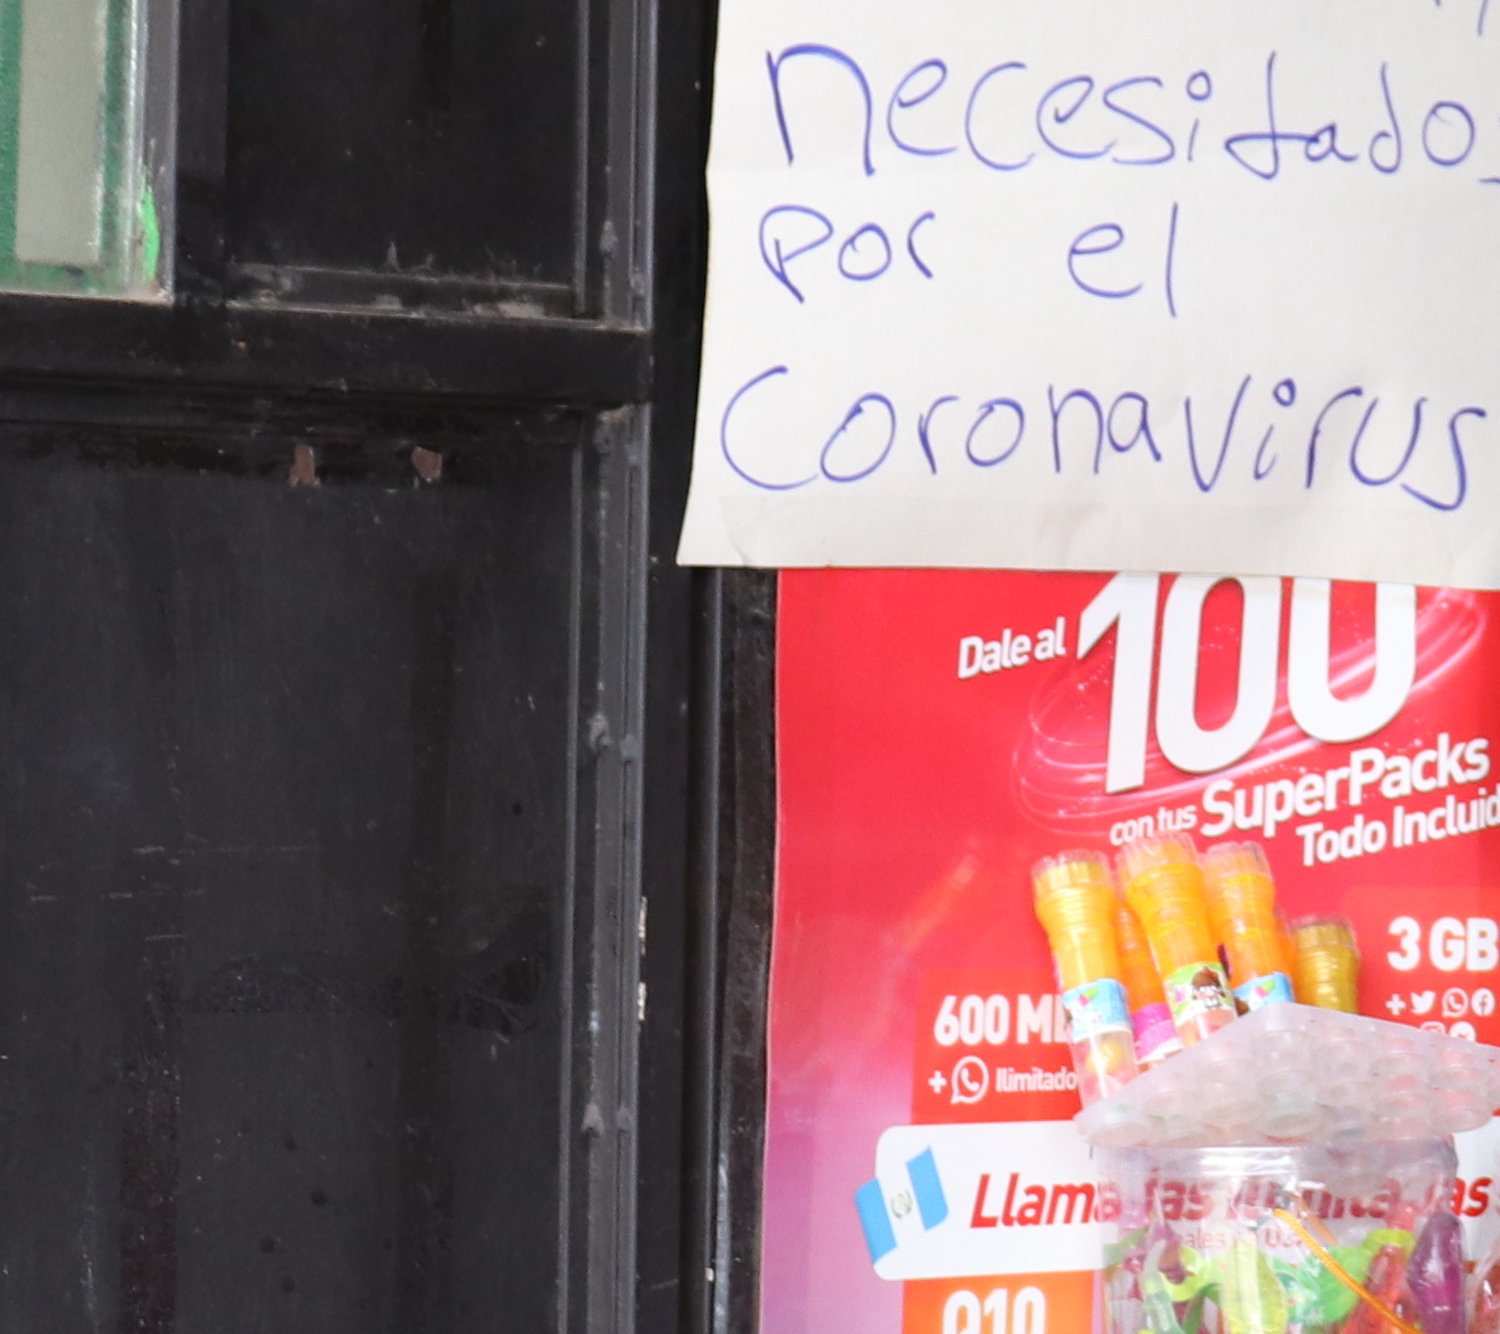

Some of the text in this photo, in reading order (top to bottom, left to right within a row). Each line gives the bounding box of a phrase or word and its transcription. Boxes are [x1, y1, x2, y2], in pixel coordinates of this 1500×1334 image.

[1066, 202, 1179, 318] el
[957, 572, 1417, 795] Dale al 100
[1109, 734, 1490, 848] con tus SuperPacks
[1297, 816, 1385, 869] Todo
[1386, 915, 1500, 973] 3 GB
[933, 995, 1010, 1047] 600
